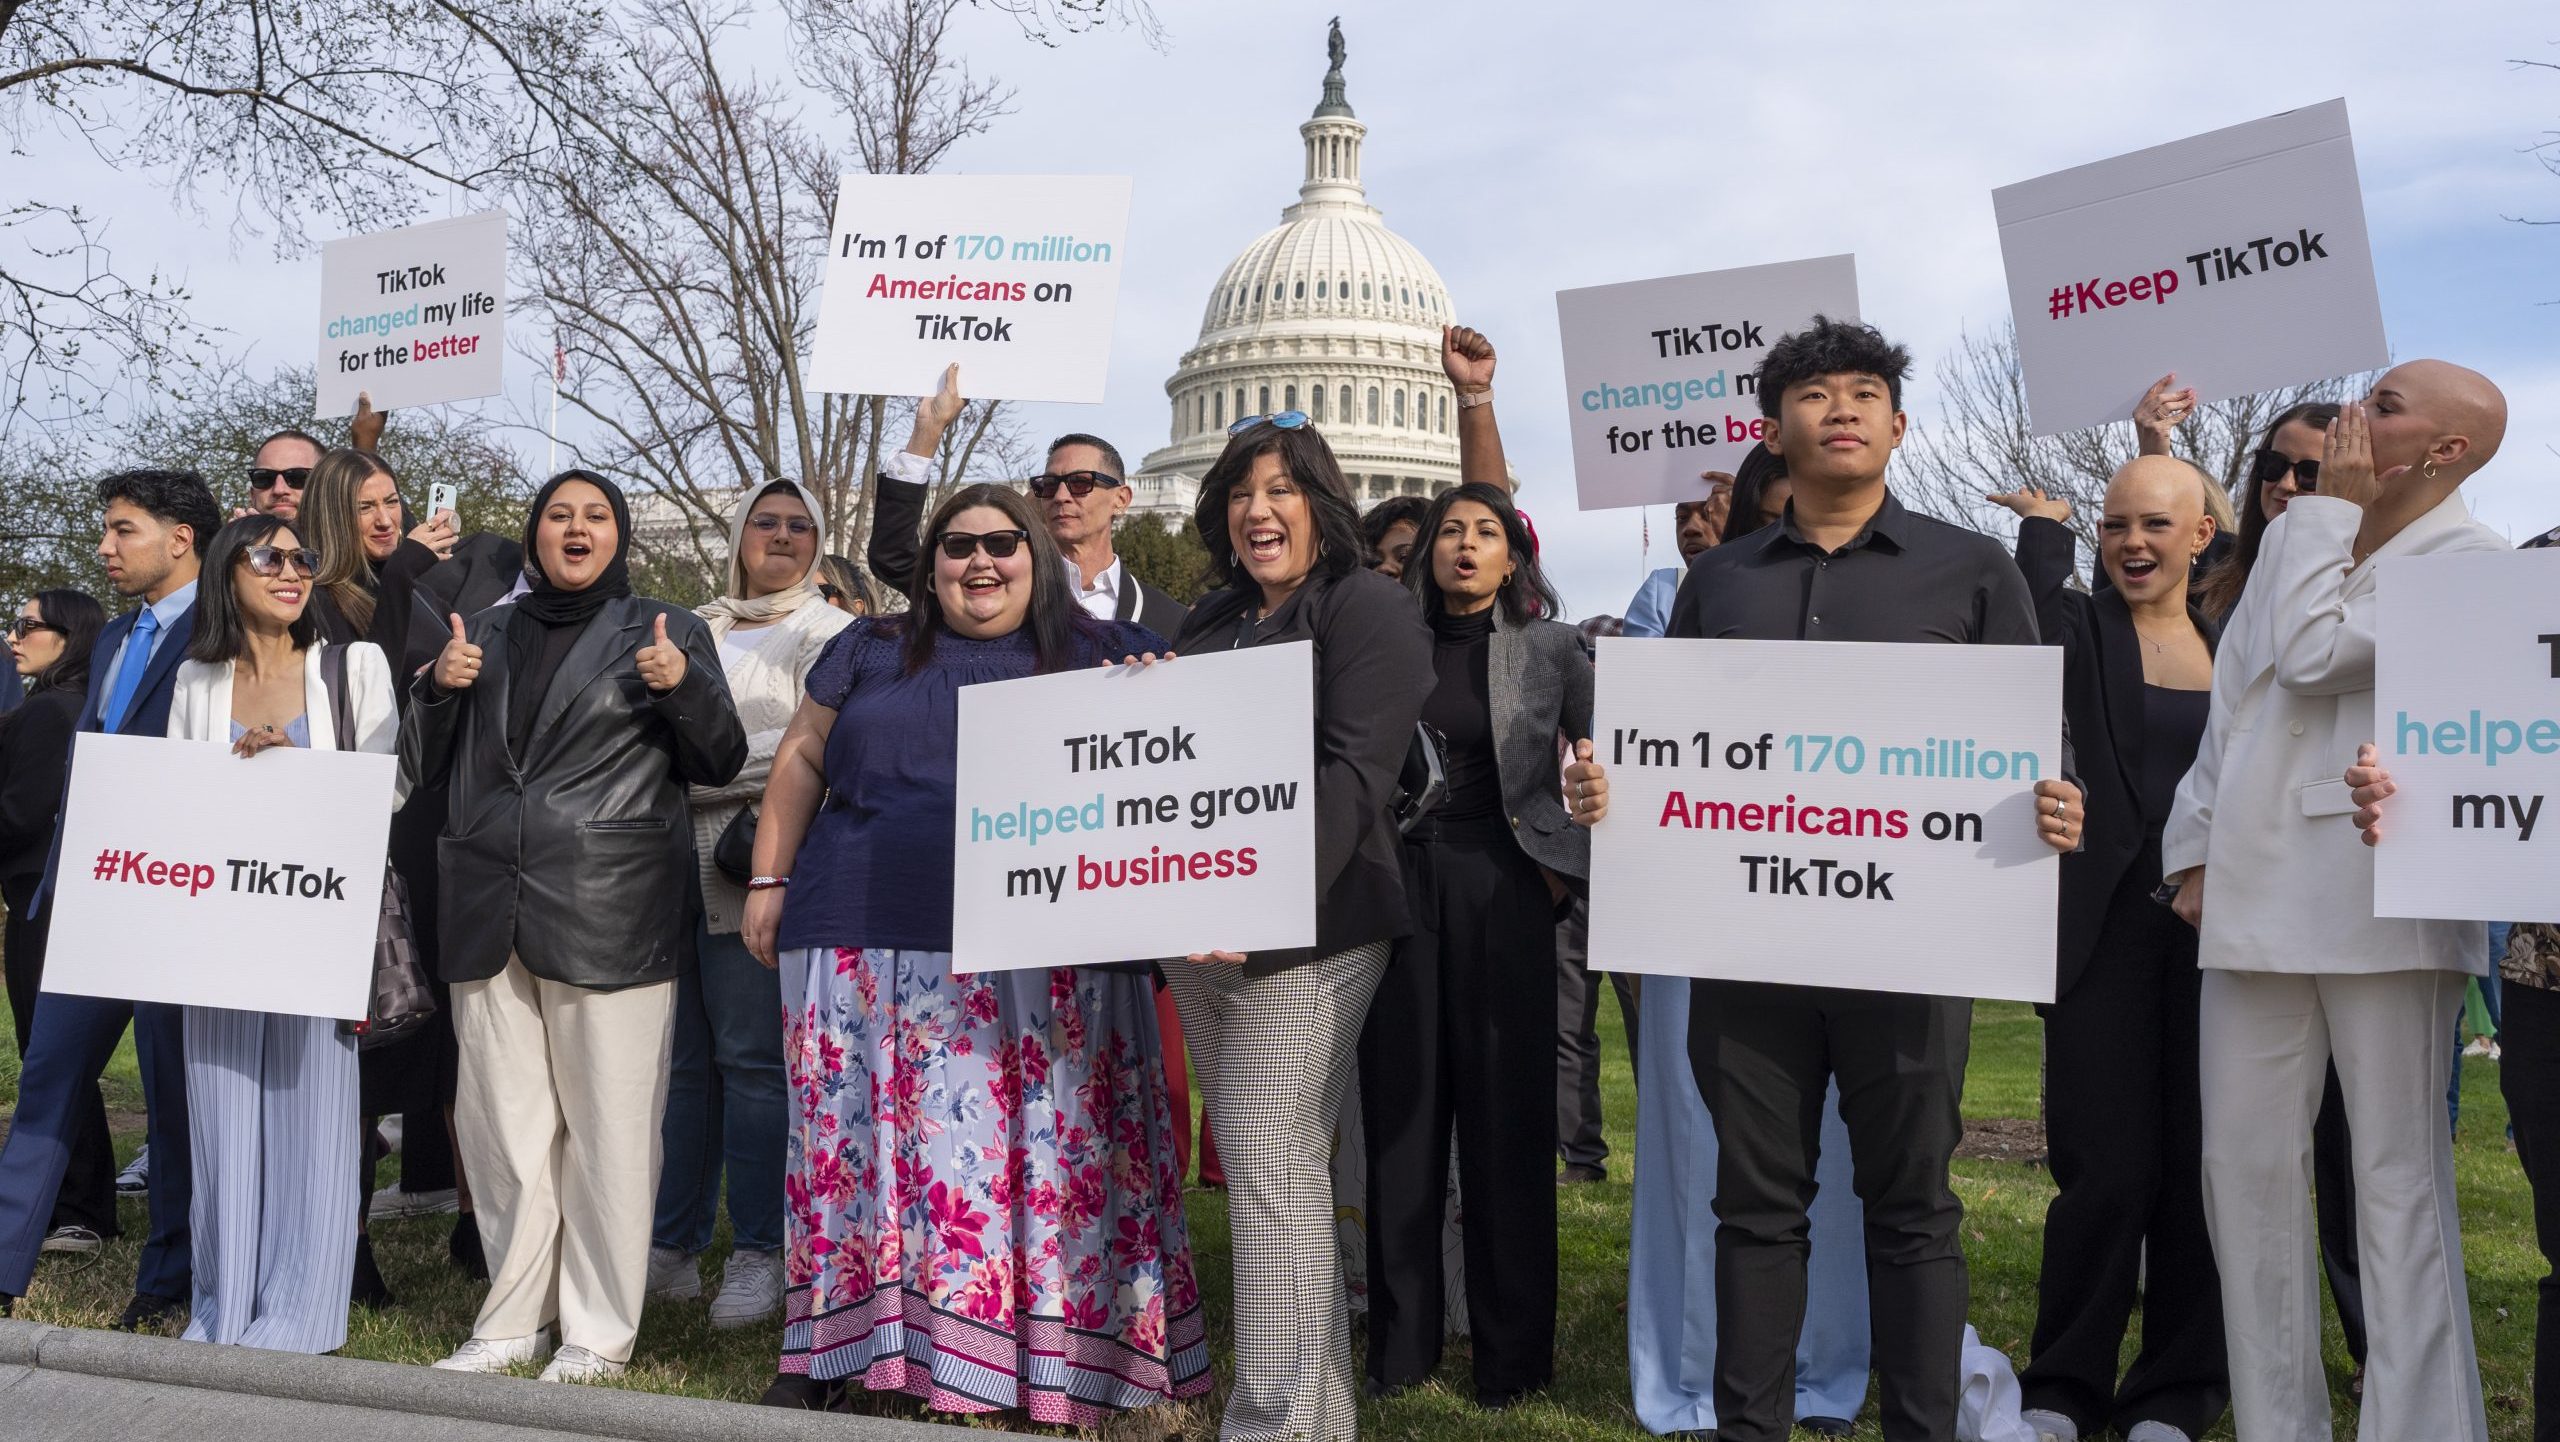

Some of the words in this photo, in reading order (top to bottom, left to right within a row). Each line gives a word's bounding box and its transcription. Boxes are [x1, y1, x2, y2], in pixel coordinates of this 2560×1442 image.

[842, 233, 886, 258] I'm
[895, 235, 907, 258] 1
[915, 235, 947, 259] of
[955, 236, 1004, 260] 170
[1012, 236, 1111, 262] million
[377, 263, 445, 294] TikTok
[866, 274, 1026, 301] Americans
[1034, 283, 1072, 302] on
[2049, 270, 2178, 320] #Keep
[2186, 229, 2328, 286] TikTok
[328, 304, 418, 339] changed
[424, 302, 456, 326] my
[462, 292, 494, 317] life
[916, 314, 1012, 341] TikTok
[339, 350, 368, 373] for
[374, 344, 408, 367] the
[414, 334, 480, 362] better
[1651, 320, 1765, 359] TikTok
[1582, 370, 1726, 411] changed
[1606, 426, 1653, 454] for
[1661, 420, 1716, 448] the
[1064, 726, 1196, 773] TikTok
[1614, 729, 1679, 767] I'm
[1693, 732, 1709, 768] 1
[1725, 733, 1773, 770] of
[1786, 735, 1865, 774] 170
[1880, 738, 2040, 781] million
[2397, 710, 2560, 766] helpe
[972, 794, 1104, 846] helped
[1117, 795, 1179, 827] me
[1190, 782, 1298, 829] grow
[1659, 791, 1908, 839] Americans
[1922, 812, 1982, 842] on
[2453, 795, 2544, 841] my
[93, 849, 215, 897] #Keep
[226, 859, 347, 900] TikTok
[1007, 865, 1067, 903] my
[1078, 846, 1257, 890] business
[1740, 855, 1894, 901] TikTok
